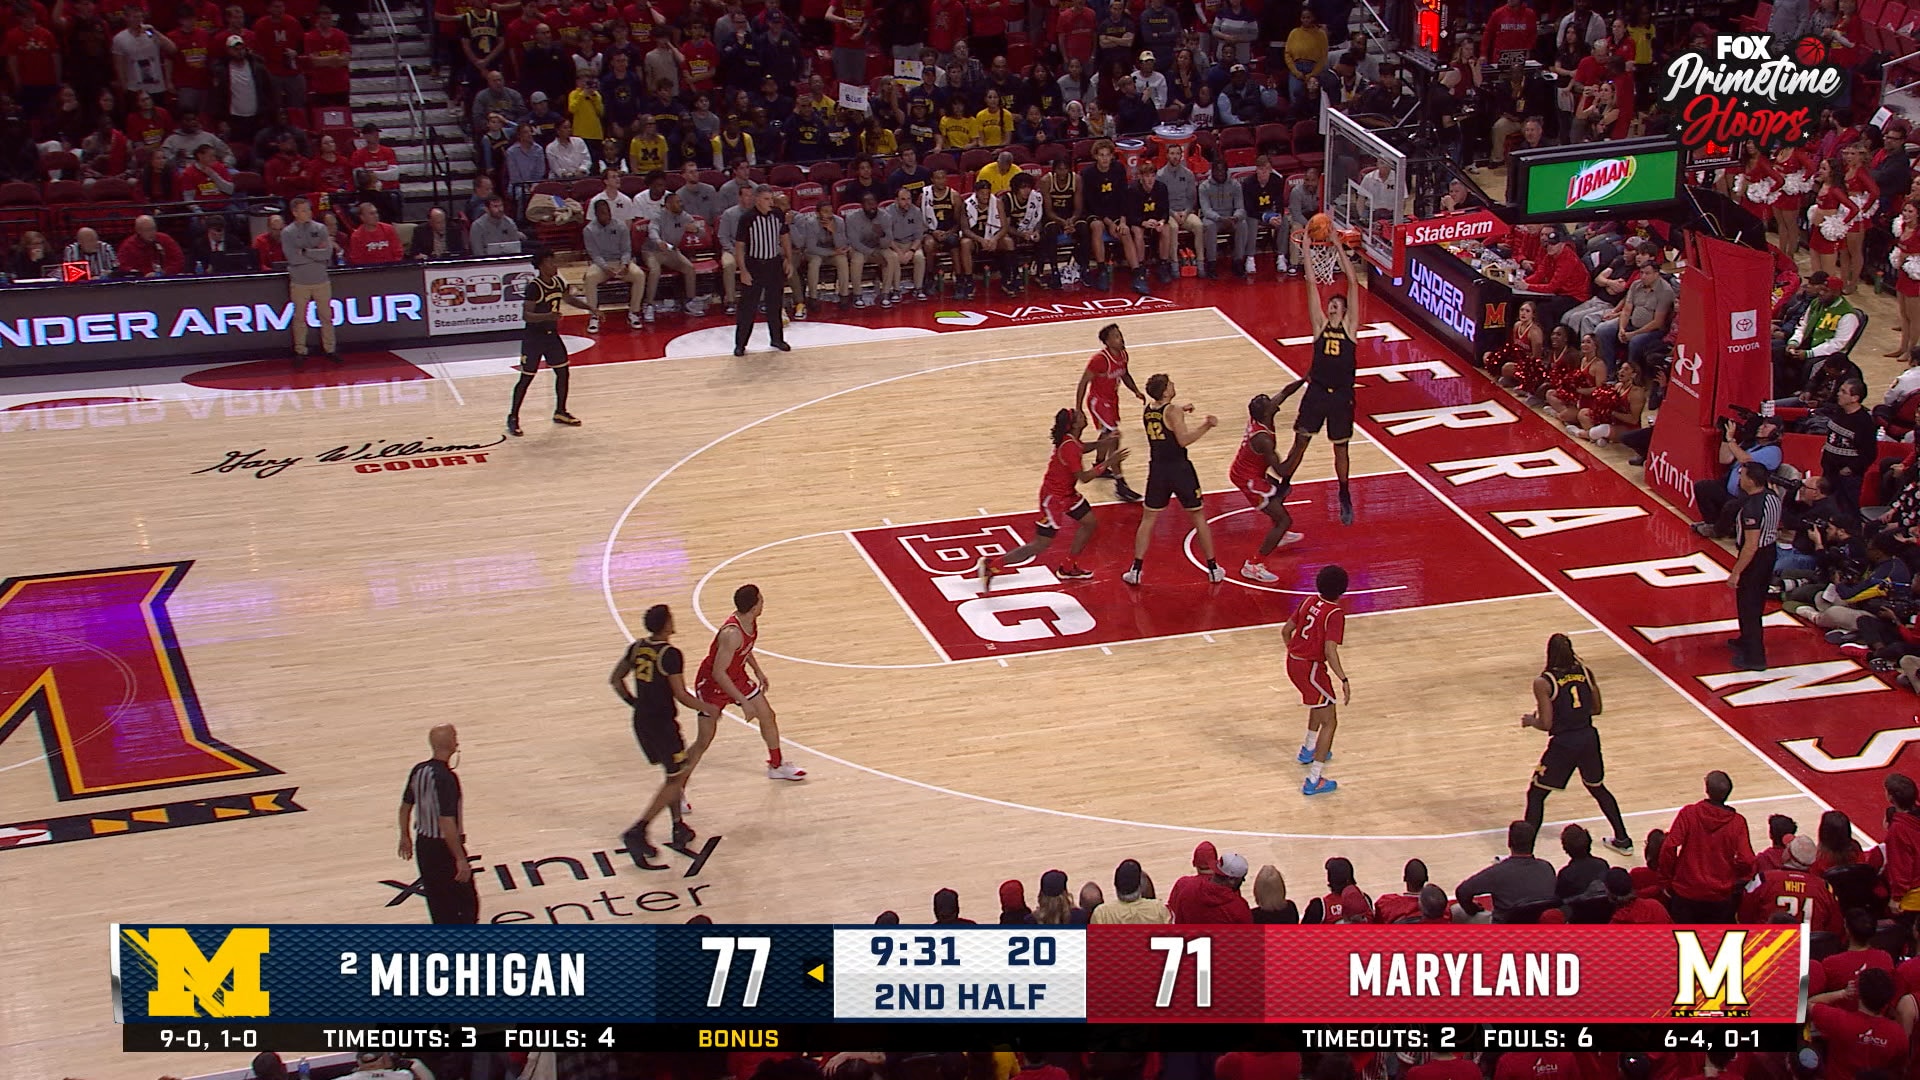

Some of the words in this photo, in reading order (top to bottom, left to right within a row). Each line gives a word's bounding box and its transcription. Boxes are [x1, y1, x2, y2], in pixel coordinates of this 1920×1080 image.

[1127, 156, 1138, 167] G
[796, 187, 823, 196] MARYLAND
[1101, 182, 1113, 193] M
[1566, 158, 1632, 208] LIBMAN
[1143, 201, 1156, 213] M
[1258, 194, 1271, 206] M
[1410, 258, 1465, 313] UNDER
[435, 303, 518, 315] STEAMFITTE
[986, 295, 1176, 319] VANDA
[1407, 281, 1477, 342] ARMOUR
[0, 309, 160, 348] NDER
[169, 293, 423, 338] ARMOUR
[434, 313, 523, 329] Steamfitters-602.
[1818, 312, 1841, 331] M
[1323, 339, 1341, 356] 15
[1727, 341, 1760, 354] TOYOTA
[1147, 421, 1167, 441] 42
[190, 448, 303, 479] Gary
[315, 435, 506, 462] Williams
[354, 452, 490, 474] COURT
[1649, 451, 1696, 508] xfinity
[1300, 614, 1315, 640] 2
[1569, 685, 1582, 709] 1
[1784, 880, 1806, 893] WHIT
[490, 884, 711, 924] enter
